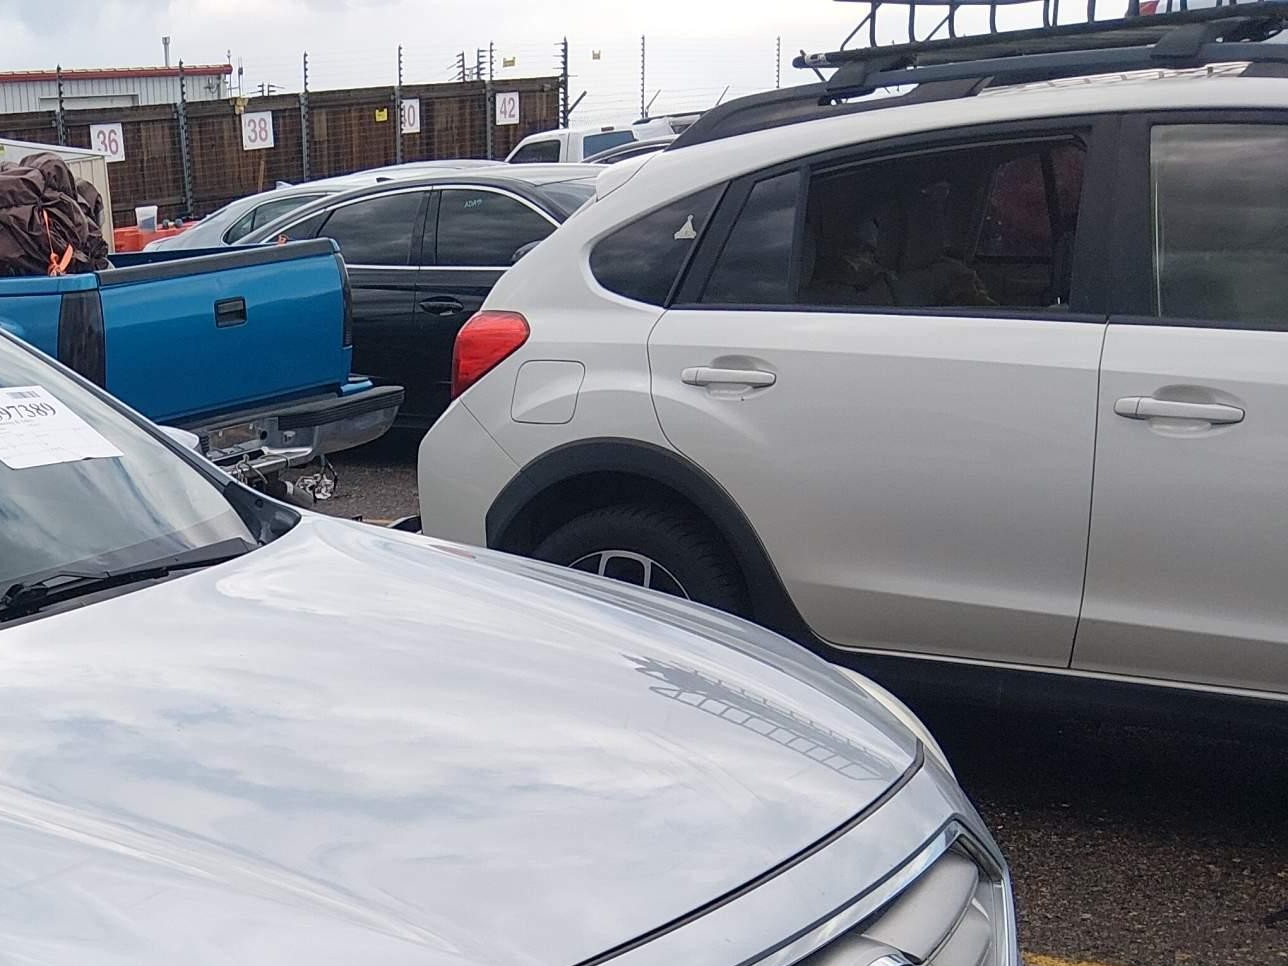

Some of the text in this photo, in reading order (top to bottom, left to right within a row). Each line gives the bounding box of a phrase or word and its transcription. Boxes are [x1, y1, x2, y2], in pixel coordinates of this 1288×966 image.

[500, 97, 516, 119] 42
[96, 128, 119, 154] 36
[247, 117, 269, 143] 38
